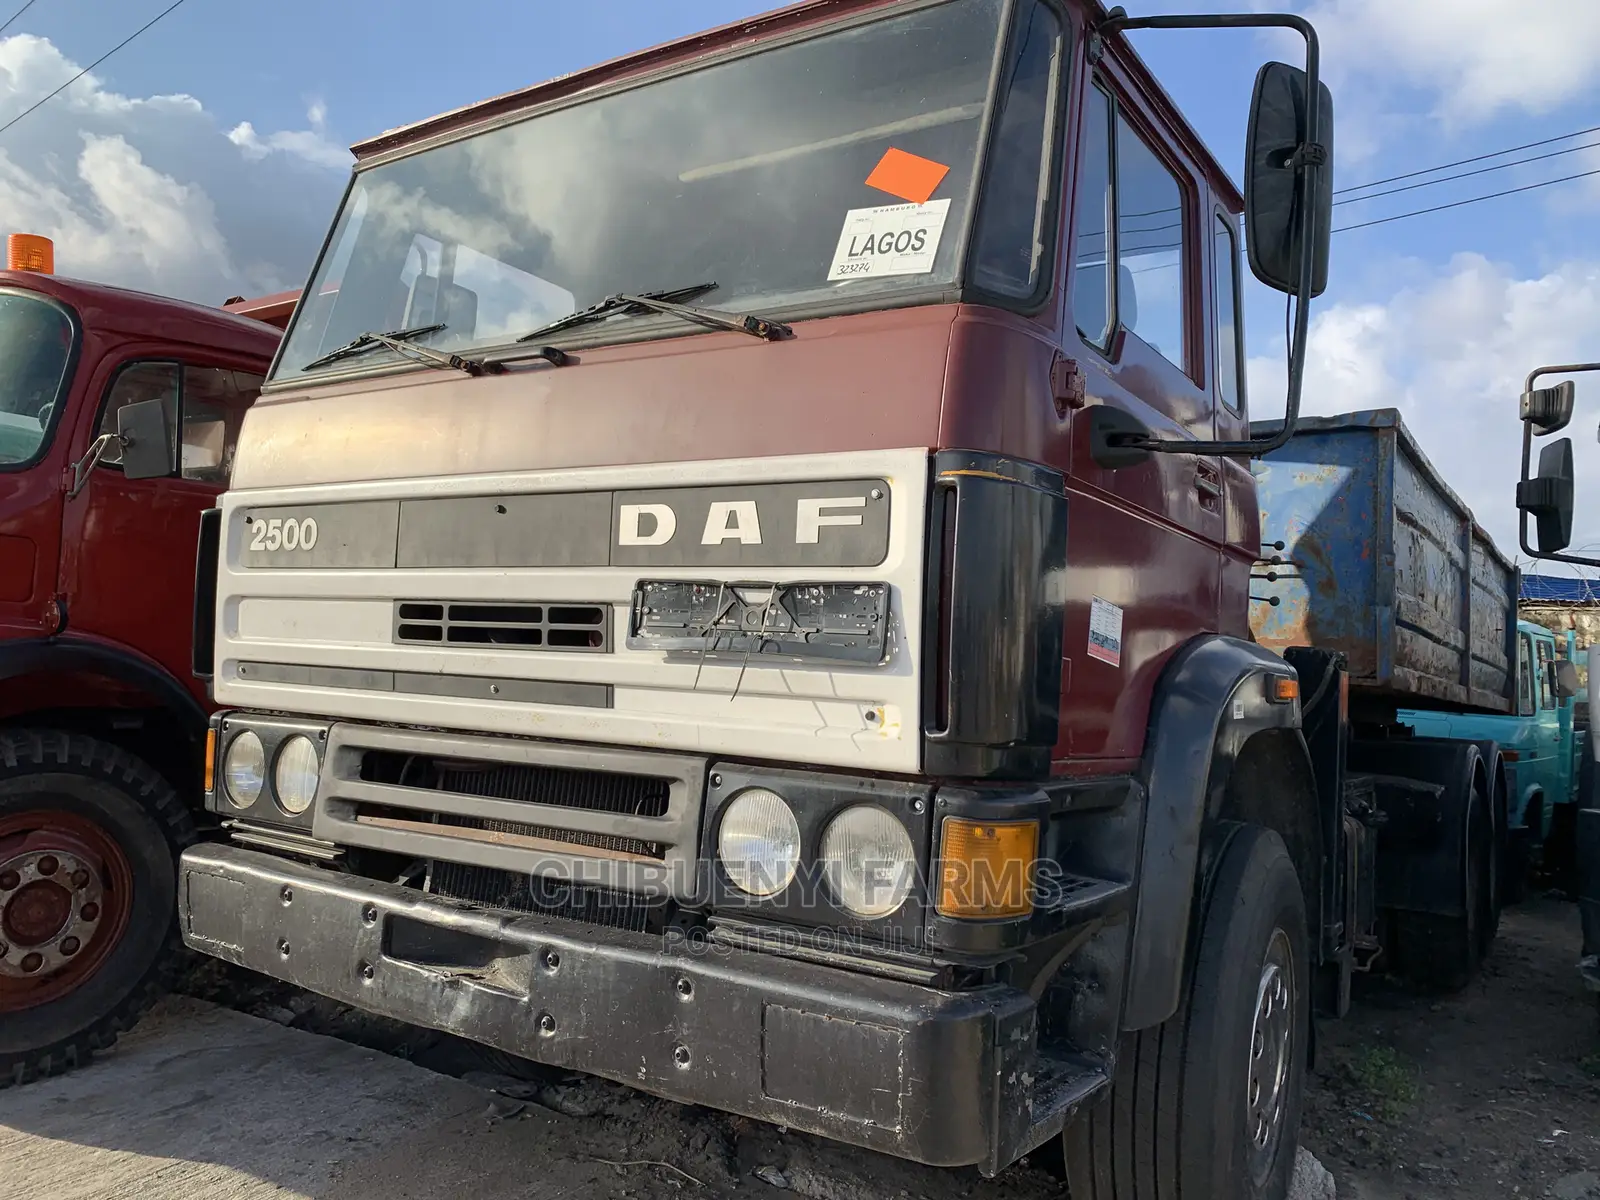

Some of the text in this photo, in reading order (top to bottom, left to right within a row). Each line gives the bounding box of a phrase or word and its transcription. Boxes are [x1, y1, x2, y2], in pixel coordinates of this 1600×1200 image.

[848, 228, 927, 257] LAGOS
[837, 262, 871, 275] 323274
[249, 517, 318, 552] 2500
[618, 496, 867, 547] DAF
